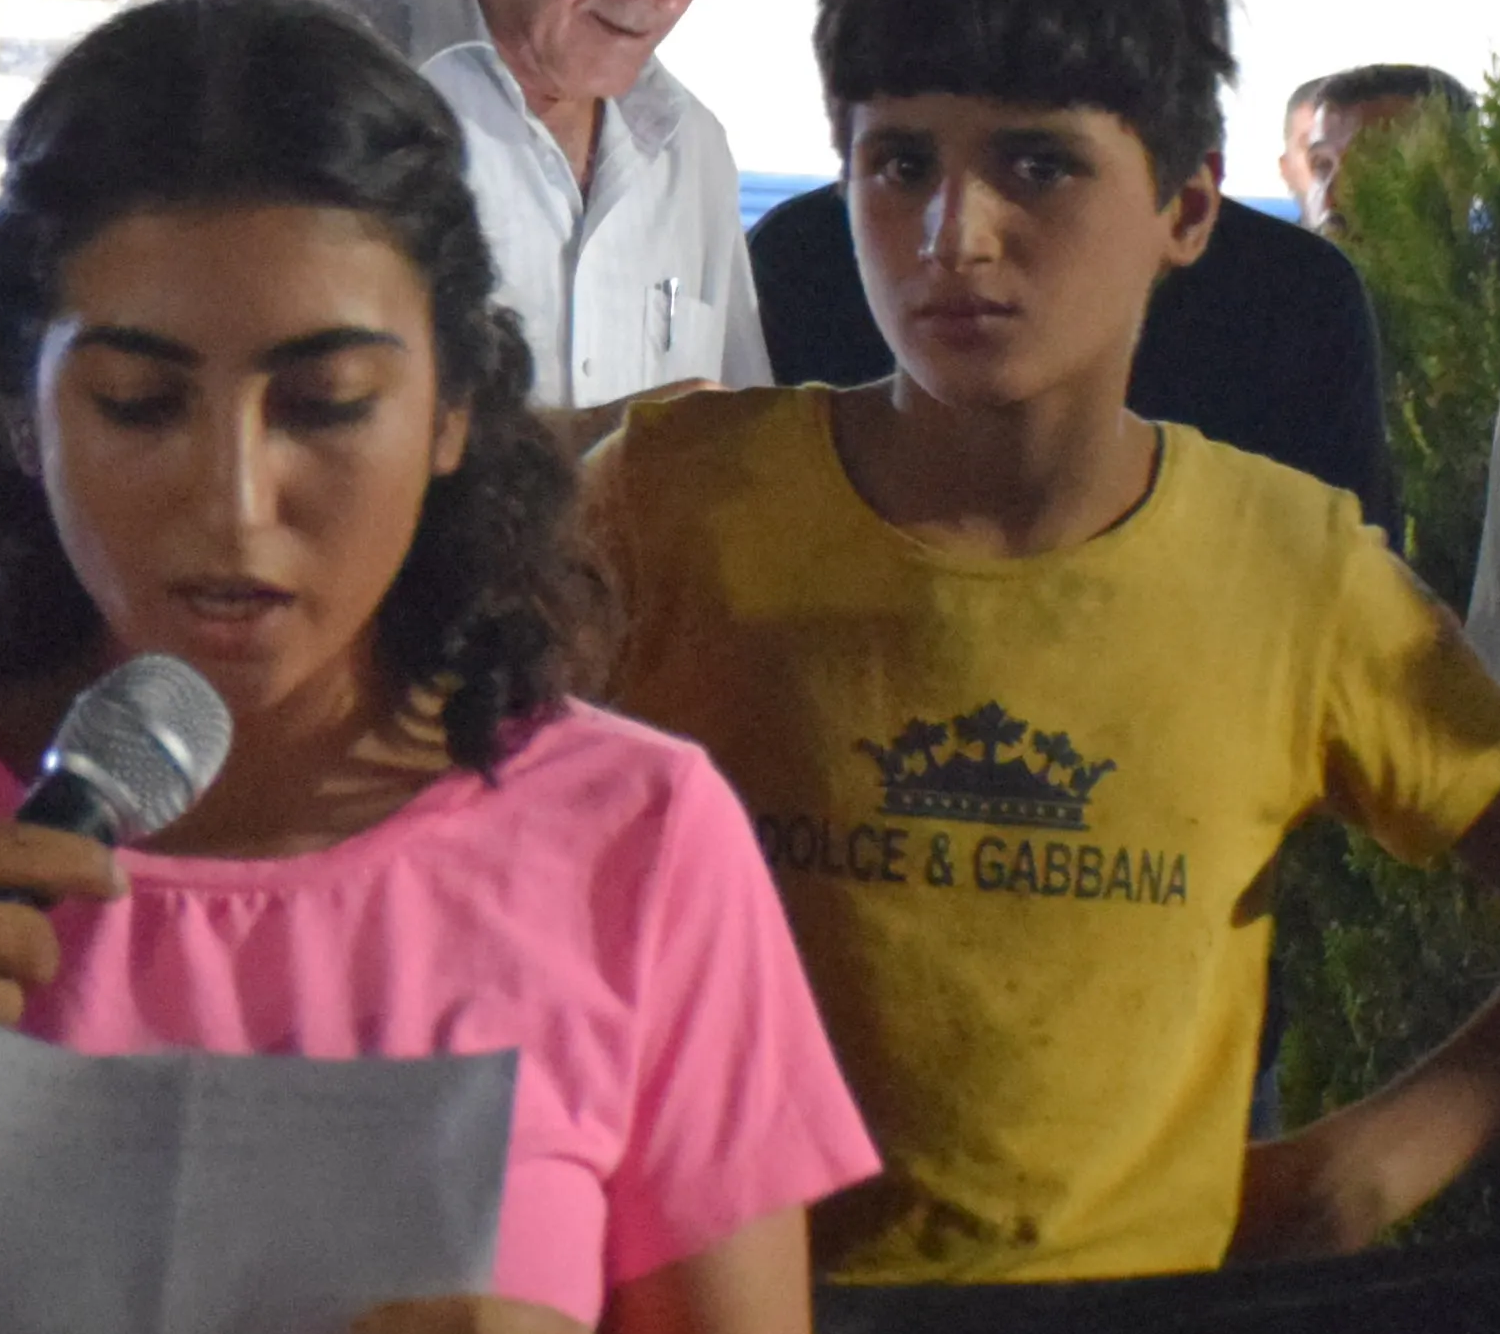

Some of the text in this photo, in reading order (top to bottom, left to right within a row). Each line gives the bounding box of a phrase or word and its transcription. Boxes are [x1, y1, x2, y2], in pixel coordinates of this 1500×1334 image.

[754, 814, 1188, 906] DOLCE & GABBANA
